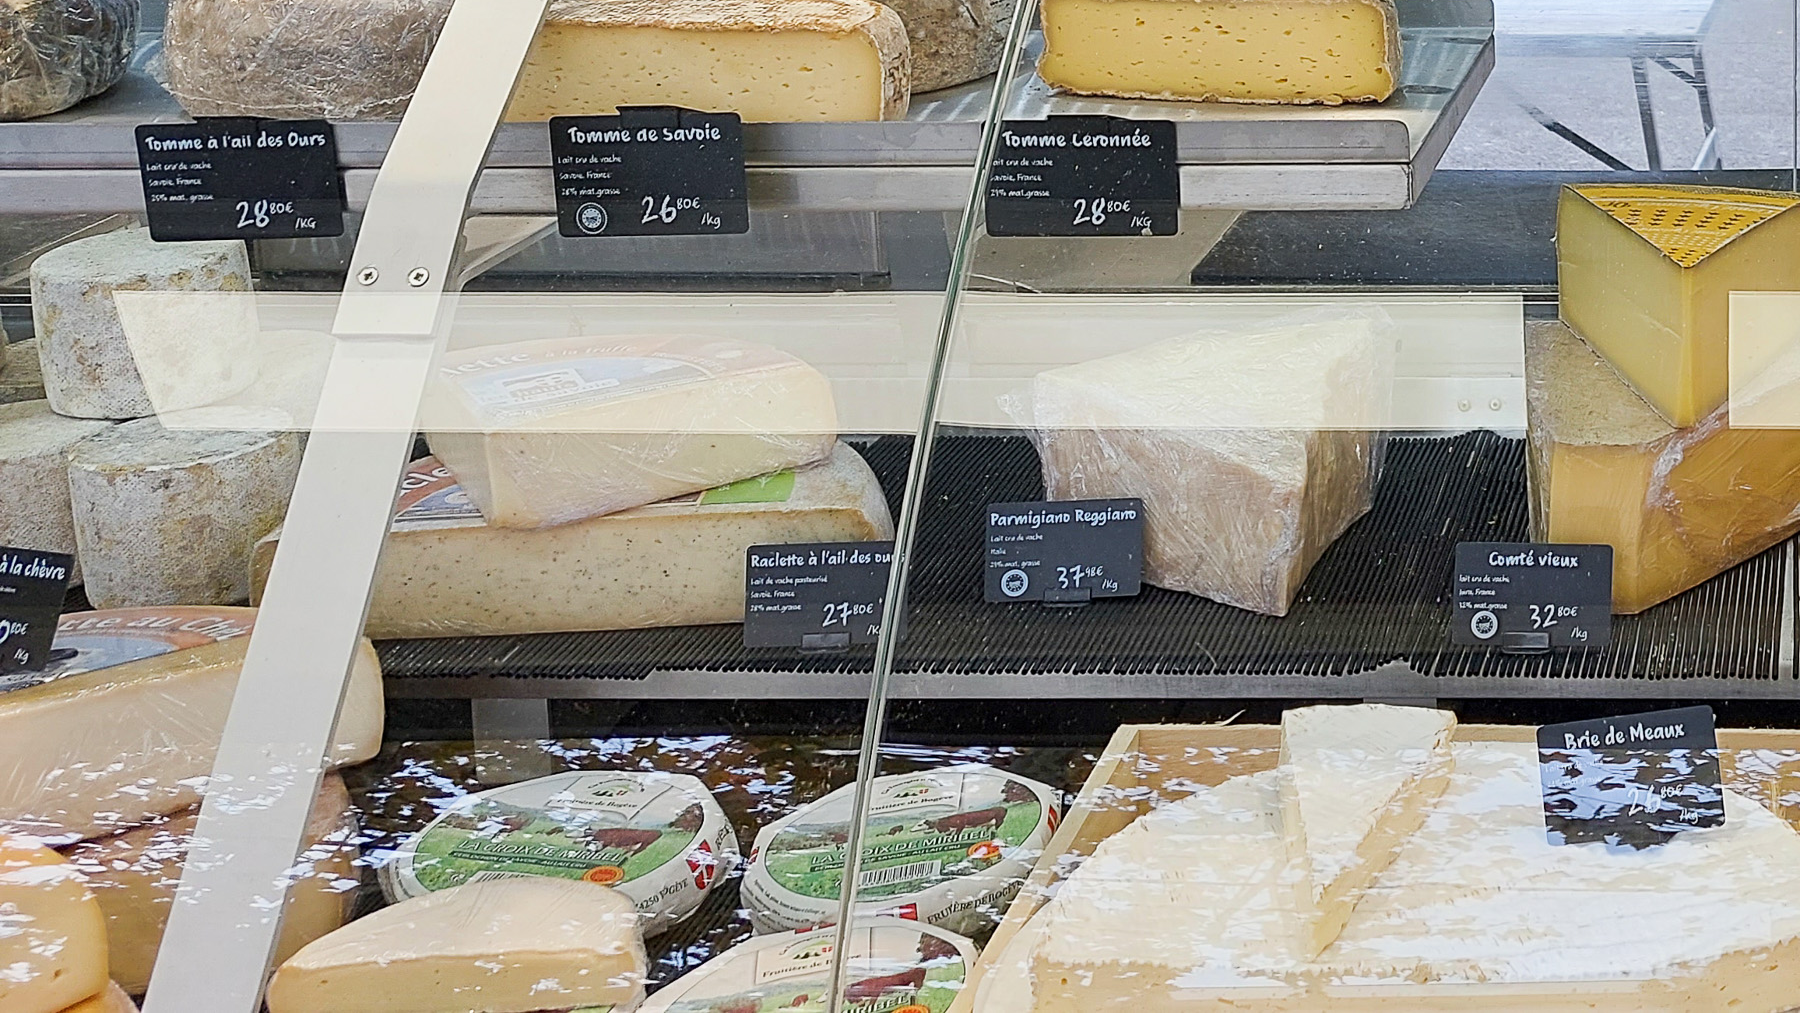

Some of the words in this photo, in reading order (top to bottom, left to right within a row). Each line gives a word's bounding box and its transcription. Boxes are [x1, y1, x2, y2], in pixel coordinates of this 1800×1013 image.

[145, 137, 202, 151] Tomme
[207, 136, 218, 149] à
[223, 135, 251, 148] l'ail
[257, 131, 283, 148] des
[288, 132, 326, 148] Ours
[568, 126, 631, 143] Tomme
[1002, 131, 1066, 148] Tomme
[235, 200, 269, 229] 28
[270, 202, 294, 214] 80€
[641, 195, 677, 224] 26
[676, 197, 700, 209] 80€
[701, 212, 721, 230] /kg
[1073, 198, 1106, 226] 28
[1107, 200, 1131, 212] 80€
[295, 217, 316, 230] /KG
[990, 510, 1070, 529] Parmigiano
[1075, 507, 1136, 526] Reggiano
[0, 554, 8, 573] à
[9, 555, 22, 575] la
[25, 558, 65, 580] chèvre
[751, 552, 804, 568] Raclette
[808, 551, 817, 566] à
[821, 550, 846, 565] l'ail
[850, 550, 871, 564] des
[1489, 550, 1534, 567] Comté
[1539, 551, 1578, 567] vieux
[1057, 565, 1084, 589] 37
[822, 602, 852, 627] 27
[853, 603, 874, 614] 80€
[1529, 604, 1558, 630] 32
[1558, 606, 1578, 617] 80€
[1564, 730, 1600, 750] Brie
[1605, 725, 1625, 745] de
[1629, 722, 1685, 742] Meaux
[458, 840, 480, 850] LA
[483, 842, 532, 855] CROIX
[534, 846, 556, 857] DE
[559, 849, 622, 864] MIRIBEL
[811, 855, 834, 865] LA
[895, 839, 918, 852] DE
[922, 830, 991, 847] MIRIBEL
